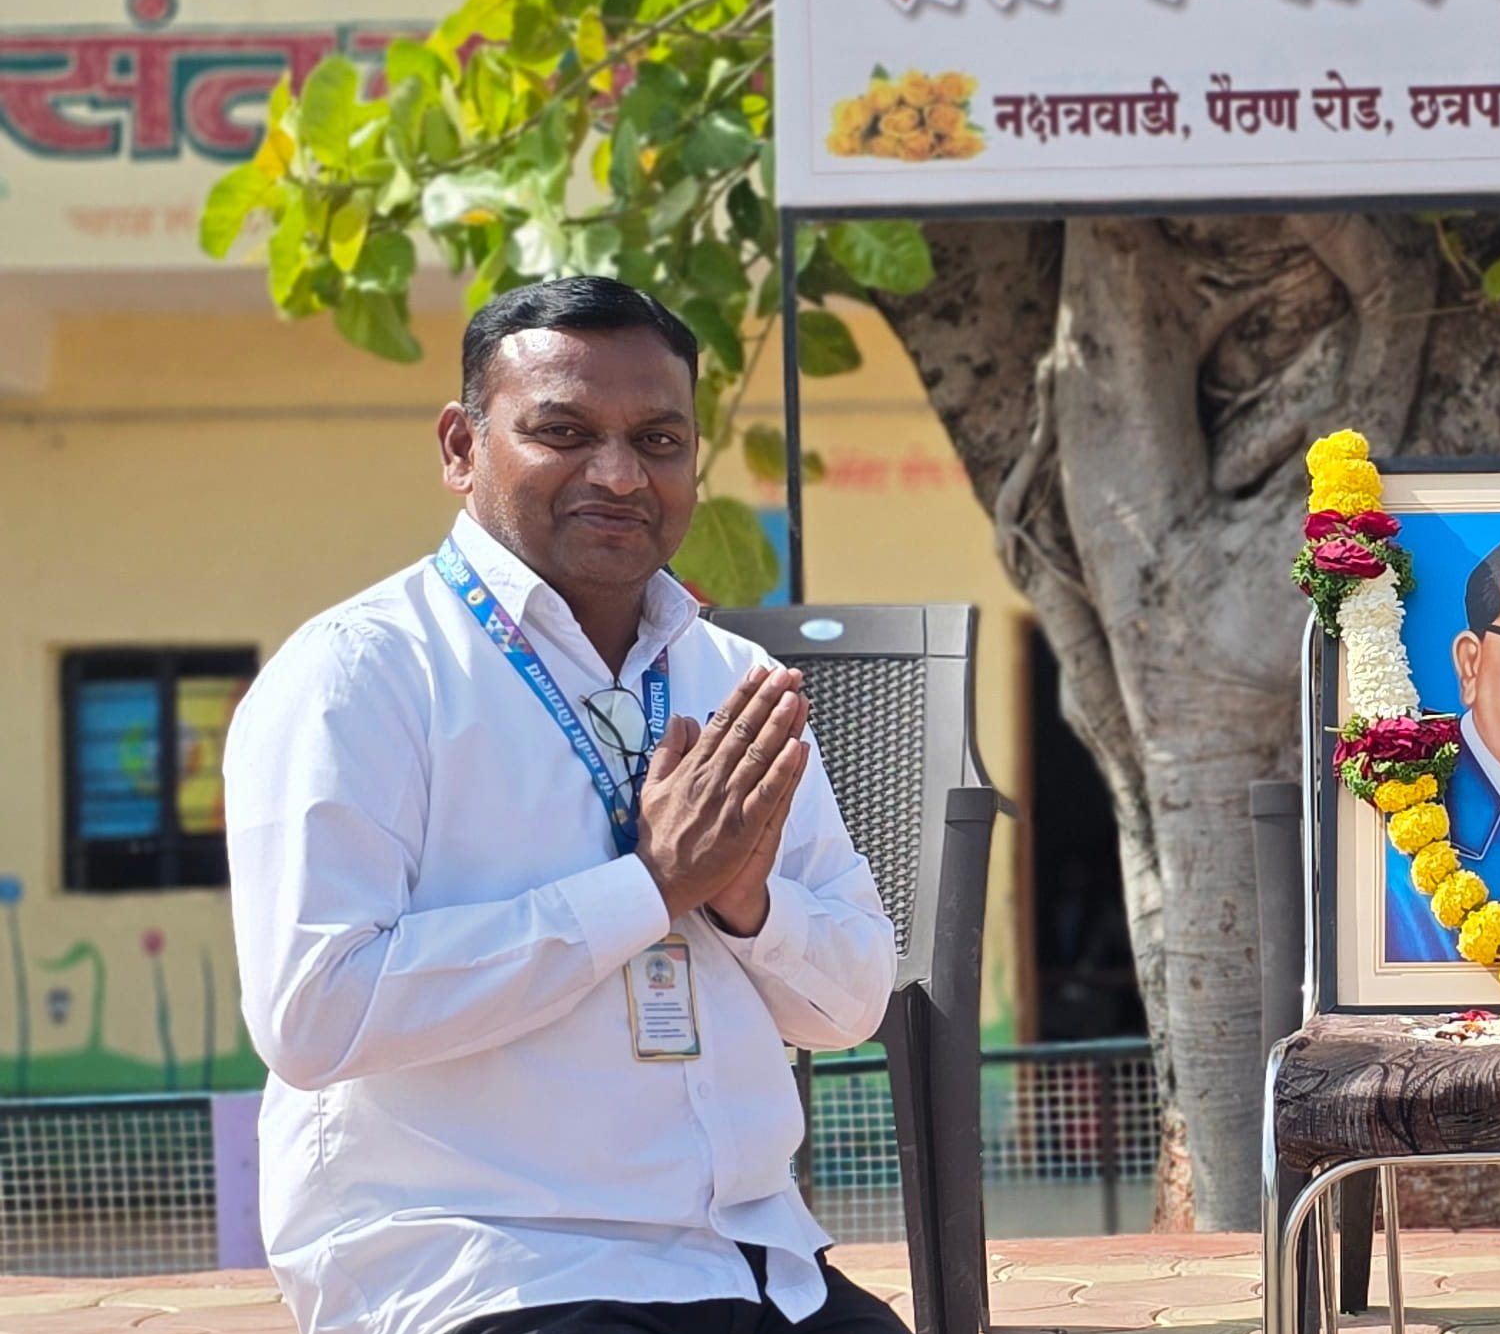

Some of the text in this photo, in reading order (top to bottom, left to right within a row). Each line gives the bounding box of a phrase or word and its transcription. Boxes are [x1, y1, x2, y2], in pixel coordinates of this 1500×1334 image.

[992, 75, 1192, 145] नक्षत्रवाडी,
[1205, 72, 1301, 134] पैठण
[1310, 69, 1395, 138] रोड,
[524, 663, 572, 727] विद्यालय
[648, 681, 665, 733] विद्यालय
[570, 728, 601, 770] कबीर
